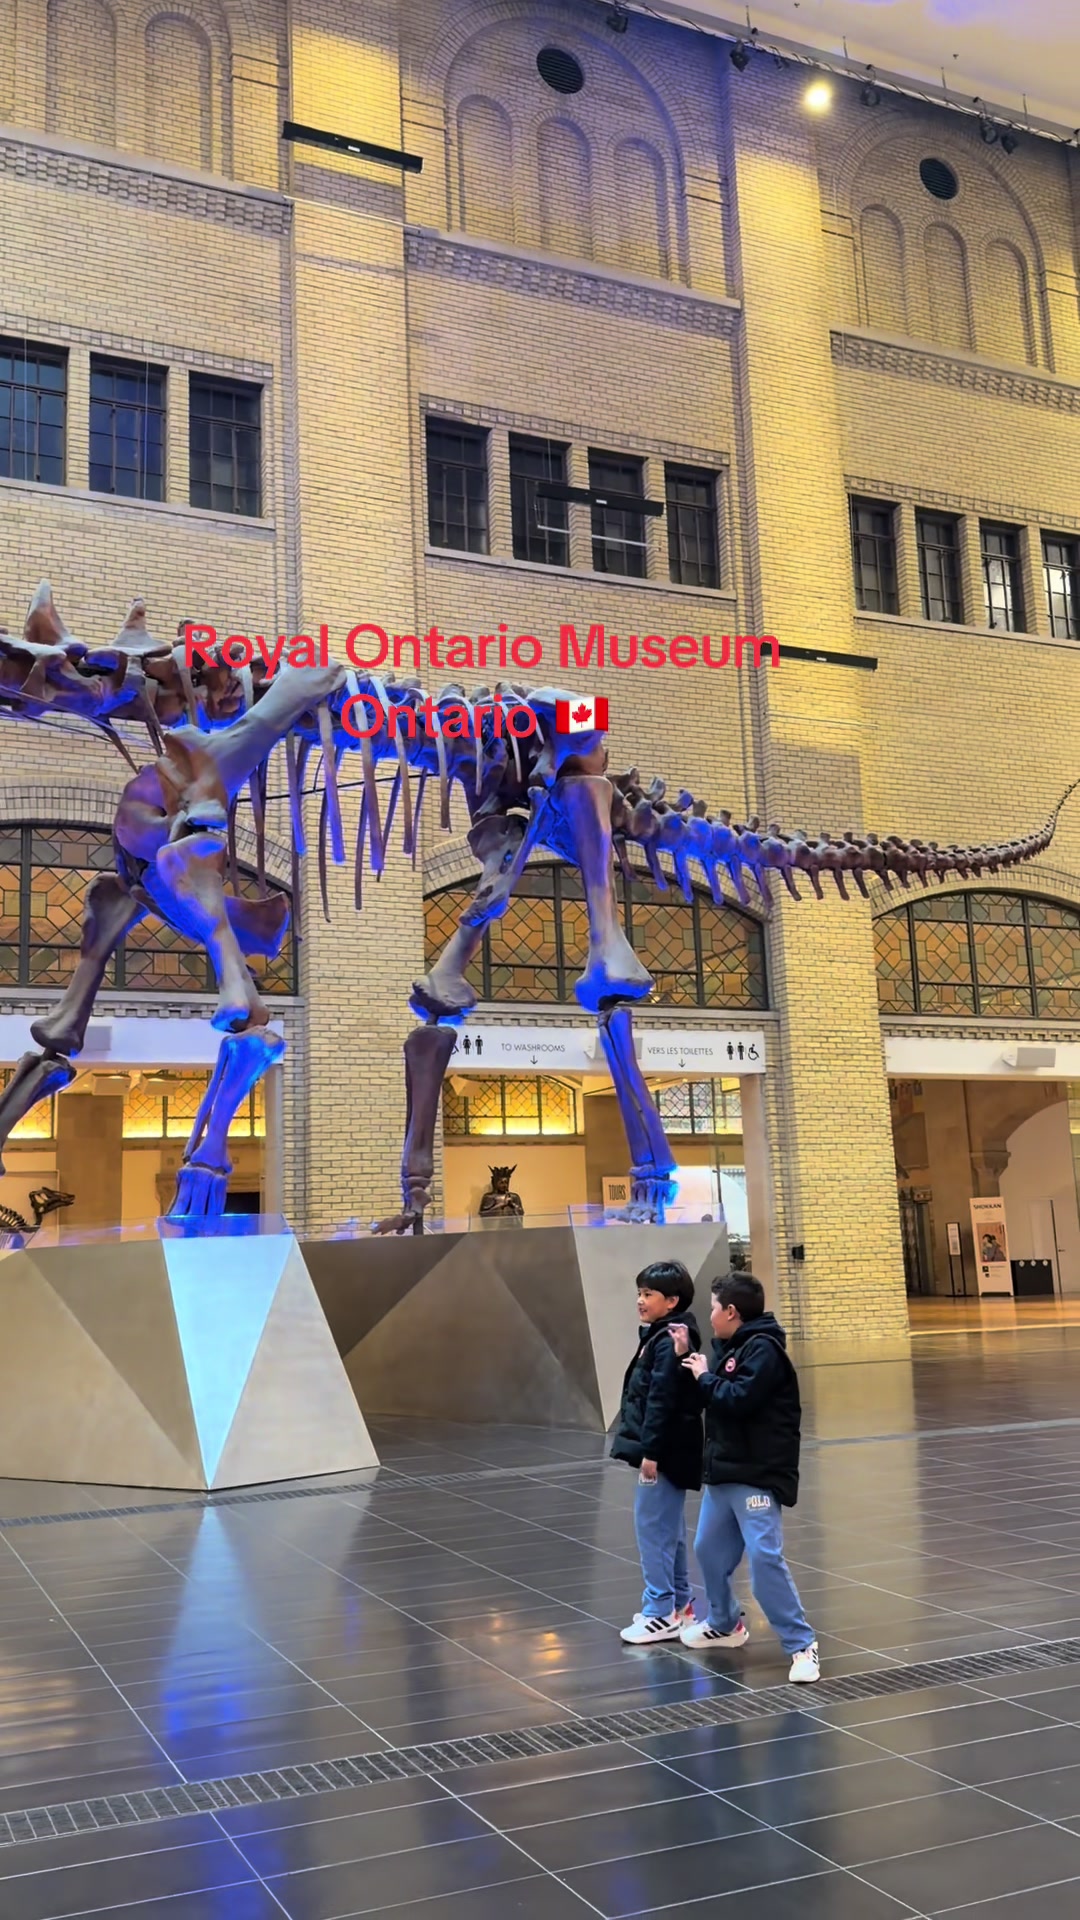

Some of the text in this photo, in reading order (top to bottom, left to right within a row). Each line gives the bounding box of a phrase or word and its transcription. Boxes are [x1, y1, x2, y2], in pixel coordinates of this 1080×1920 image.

[501, 1043, 566, 1052] TO WASHROOMS
[647, 1047, 714, 1055] VERS LES TOILETTES
[608, 1184, 627, 1201] TOURS
[745, 1495, 770, 1509] POLO
